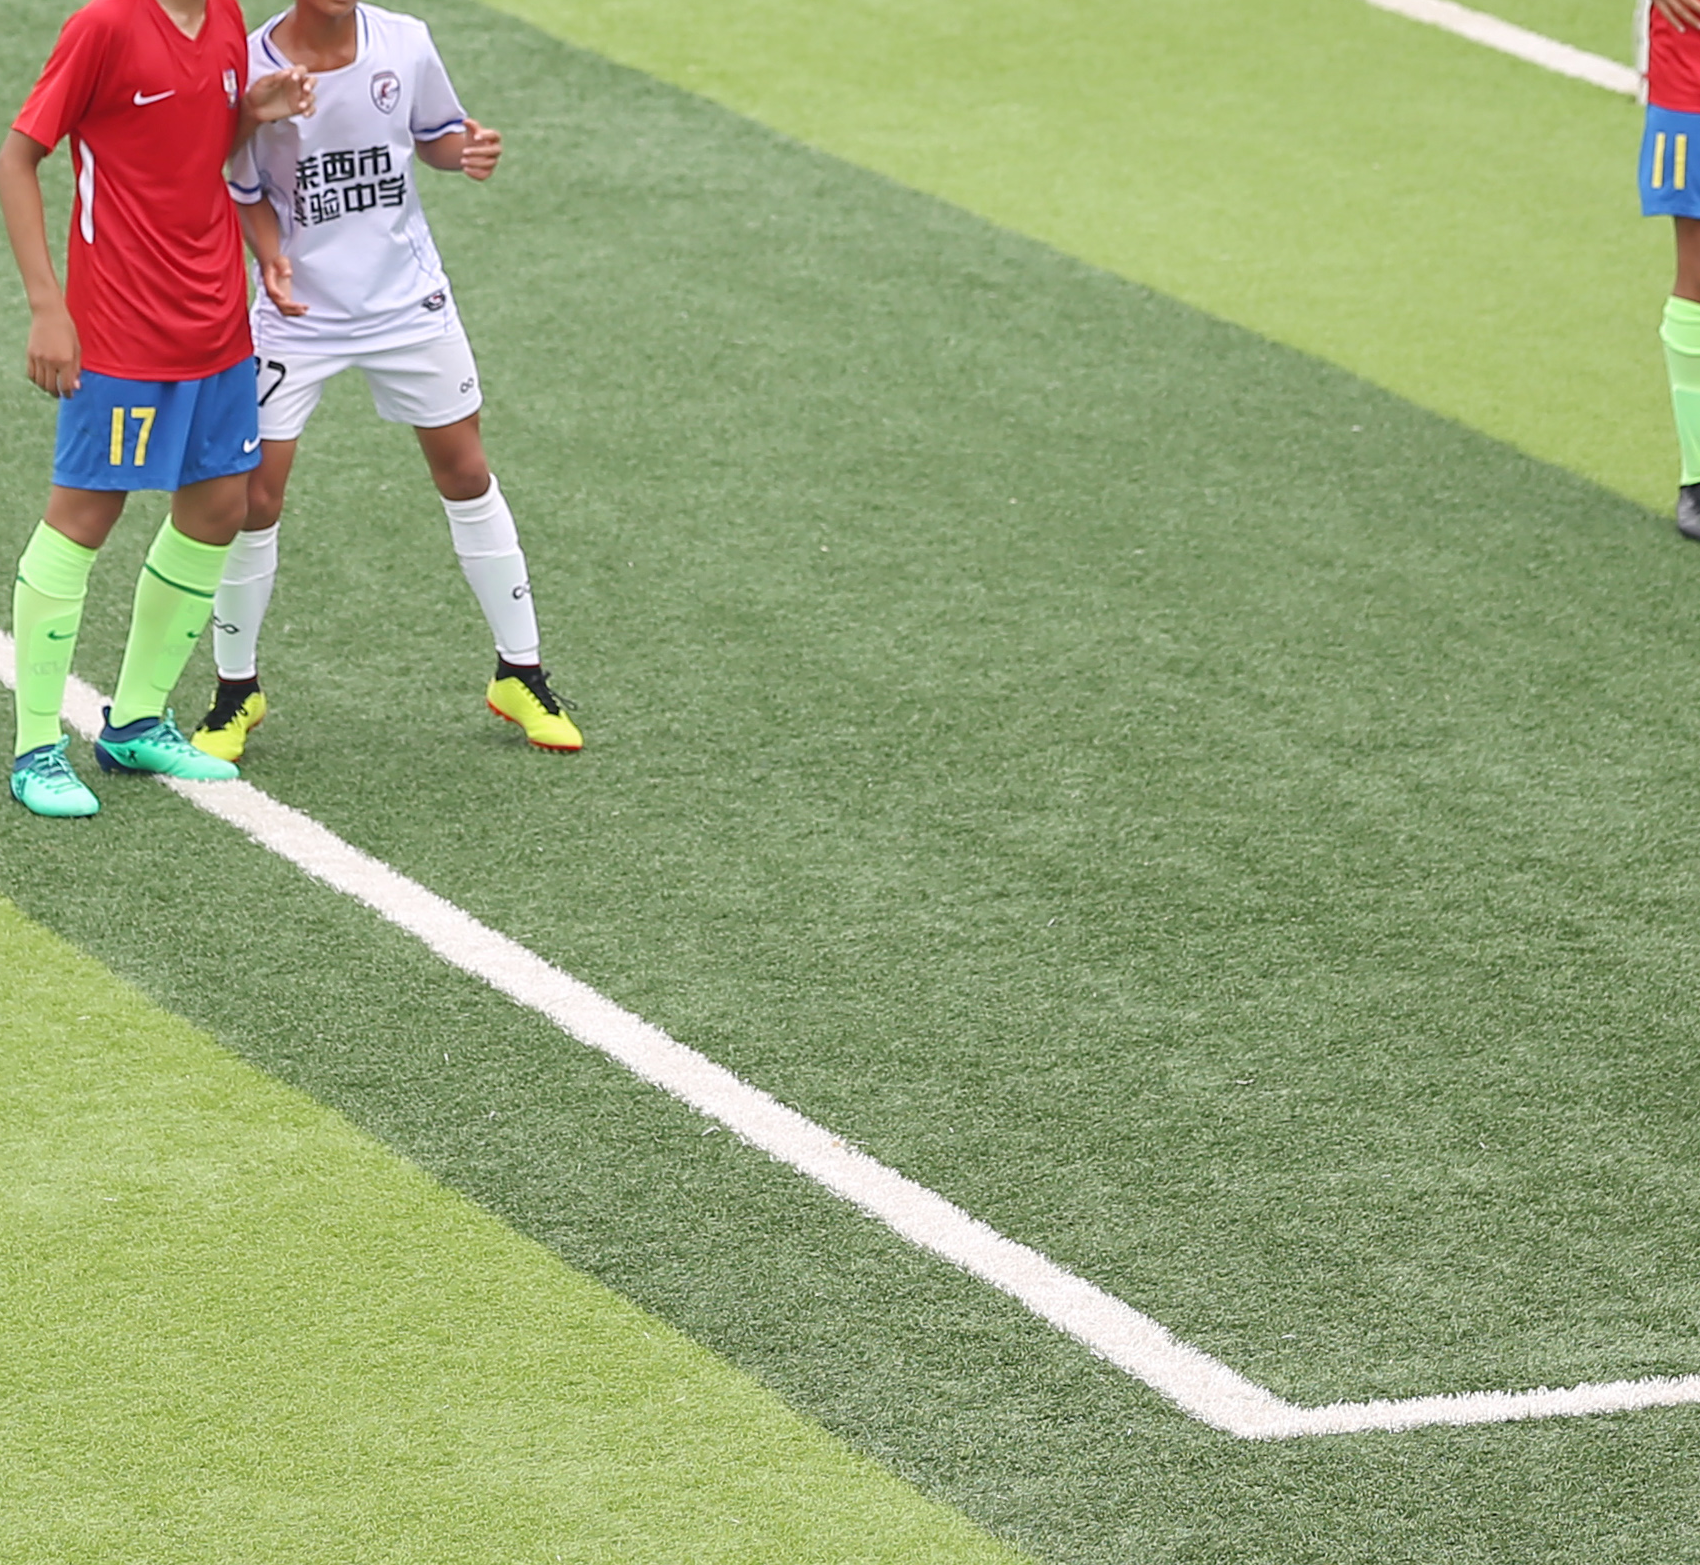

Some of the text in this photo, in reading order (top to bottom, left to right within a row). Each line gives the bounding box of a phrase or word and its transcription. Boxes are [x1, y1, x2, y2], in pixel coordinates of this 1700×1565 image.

[1651, 131, 1688, 191] 11
[253, 354, 286, 408] 7
[109, 406, 157, 467] 17
